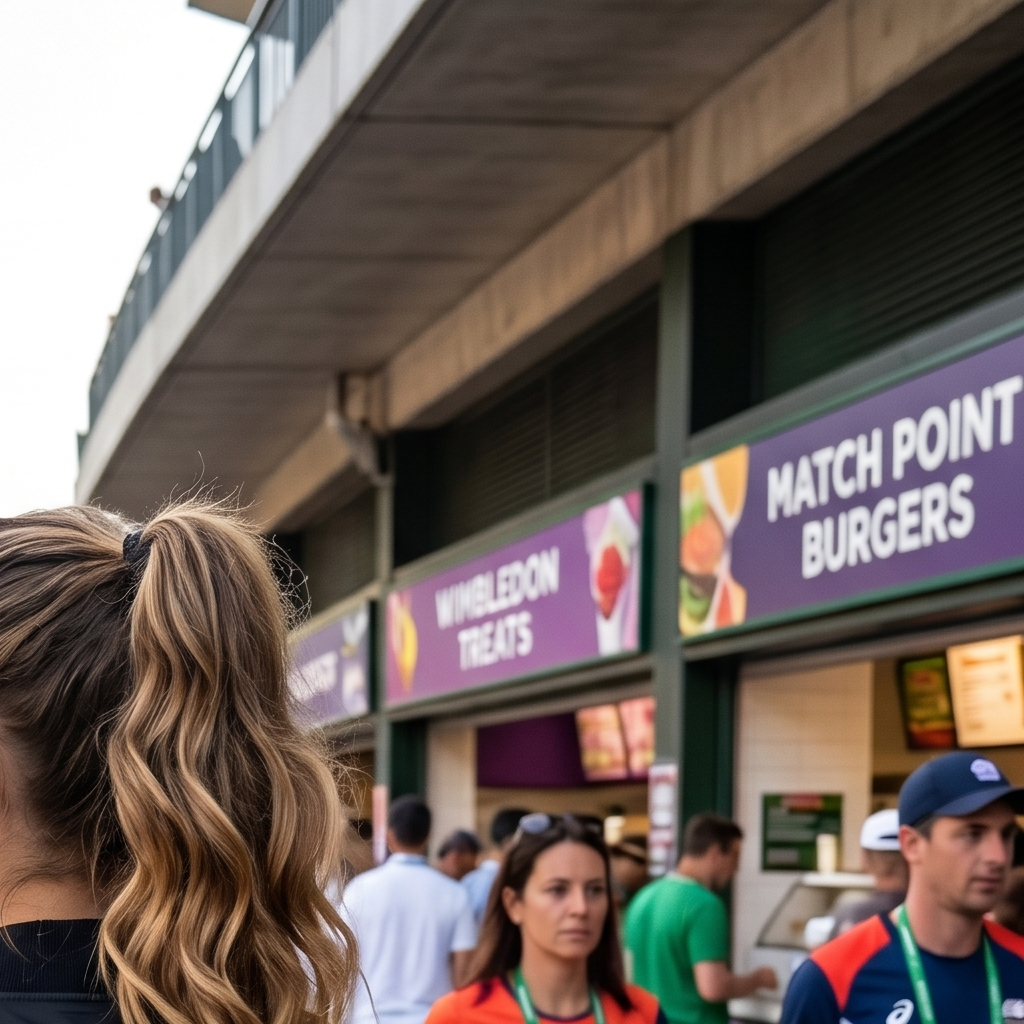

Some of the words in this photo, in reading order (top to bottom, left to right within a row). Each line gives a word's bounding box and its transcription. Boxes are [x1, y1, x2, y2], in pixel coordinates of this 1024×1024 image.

[767, 427, 883, 523] MATCH
[892, 374, 1023, 481] POINT
[802, 473, 975, 580] BURGERS
[435, 546, 560, 630] WIMBLEDON
[458, 611, 533, 671] TREATS
